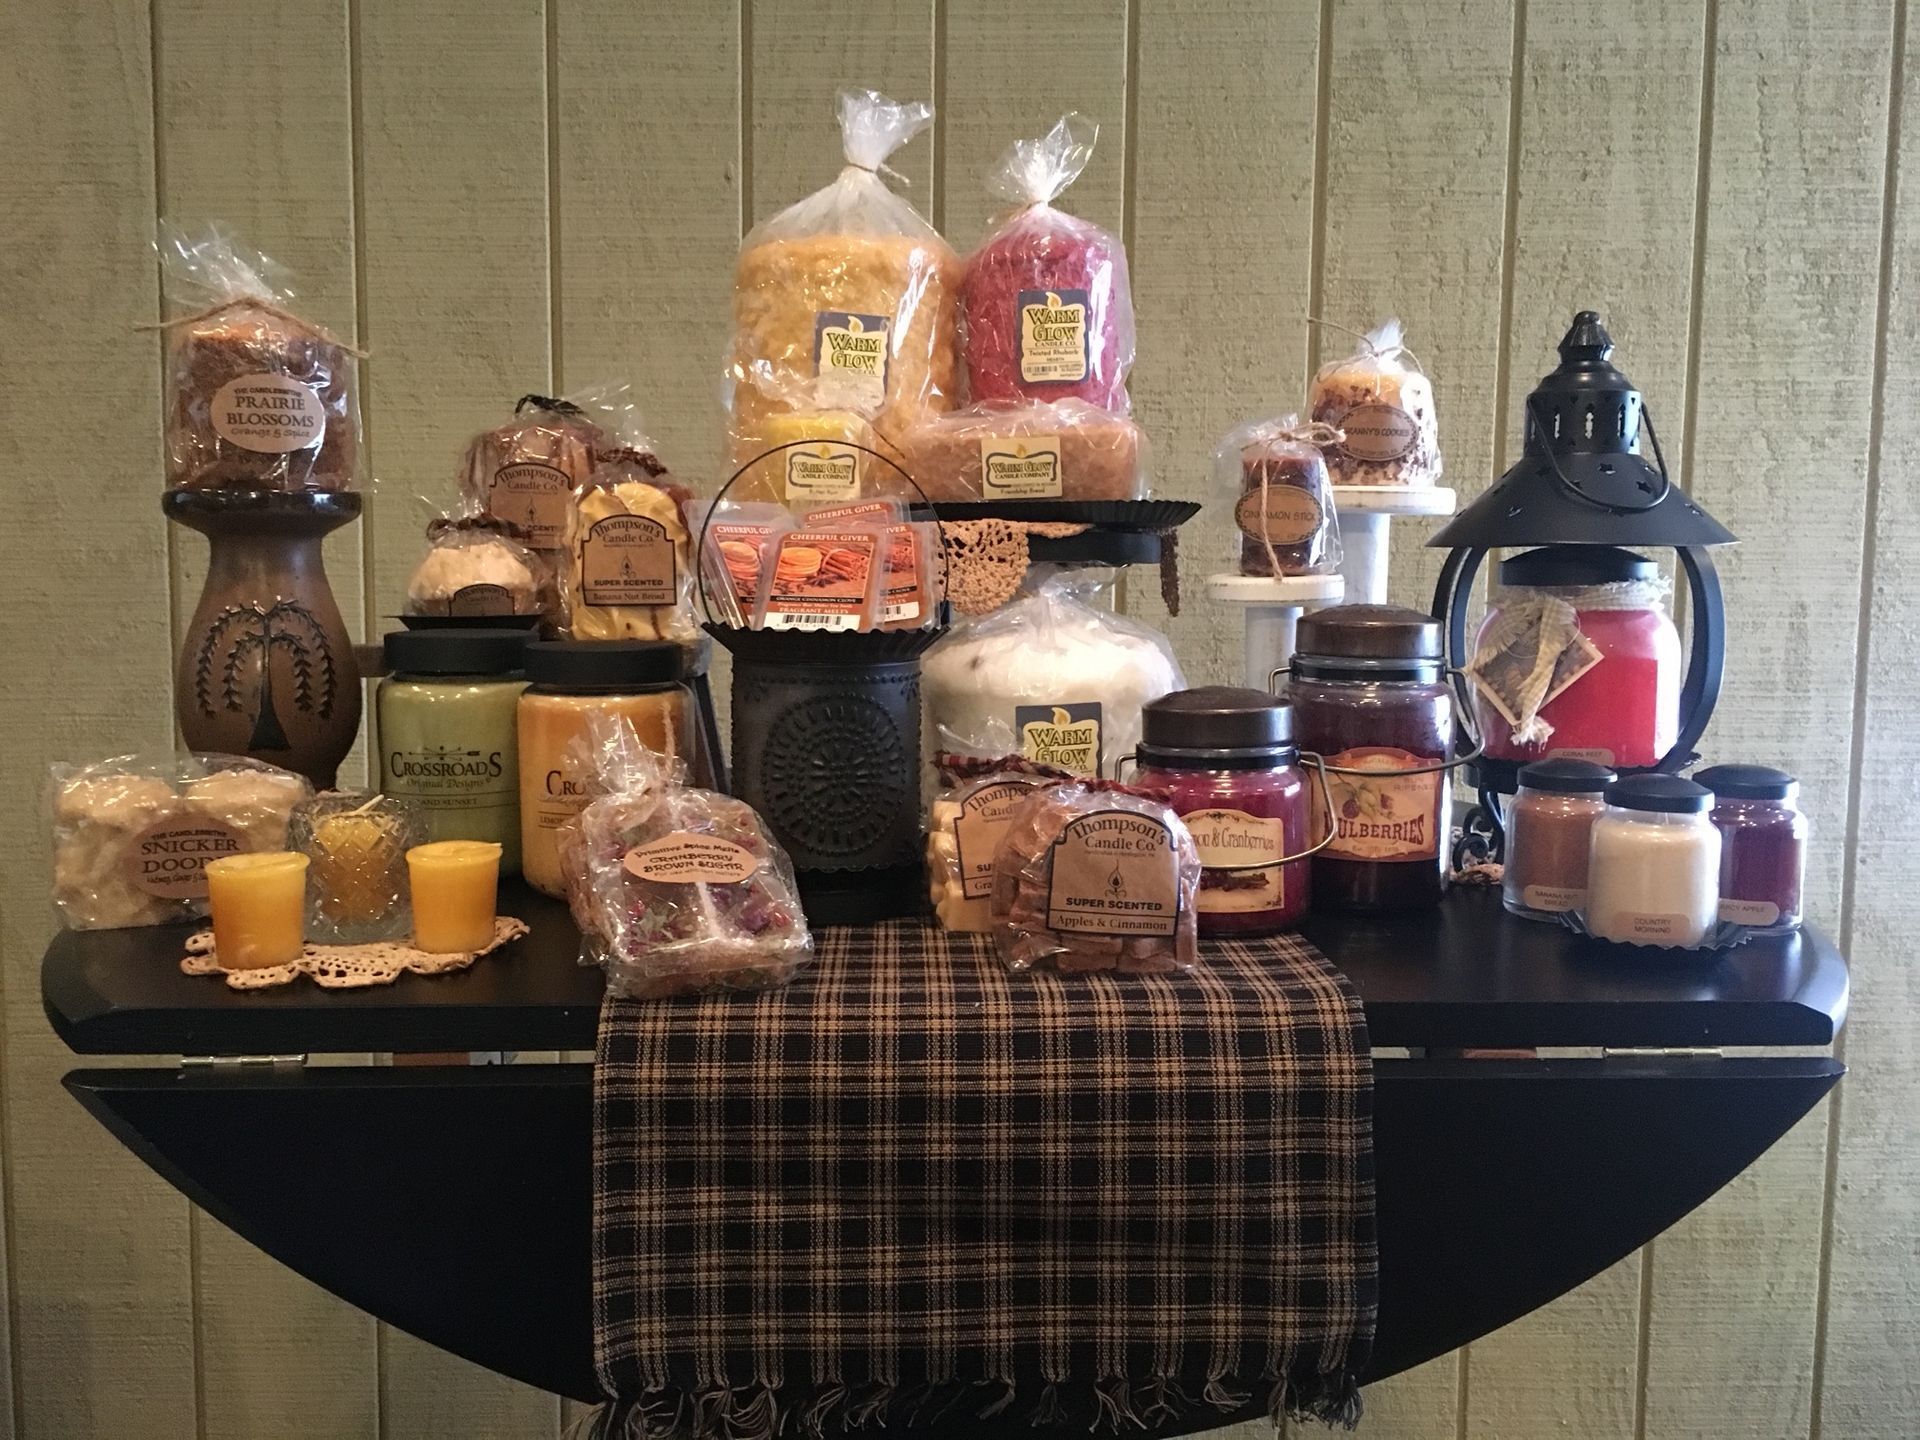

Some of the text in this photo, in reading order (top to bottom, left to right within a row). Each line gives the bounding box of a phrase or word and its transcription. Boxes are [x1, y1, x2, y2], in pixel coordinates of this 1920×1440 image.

[1026, 308, 1080, 325] WARM
[1033, 325, 1079, 342] GLOW
[826, 332, 882, 353] WARM
[831, 350, 878, 371] GLOW
[235, 396, 306, 411] PRAIRIE
[226, 412, 314, 428] BLOSSOMS
[990, 460, 1053, 474] WARM GLOW
[500, 468, 566, 487] Thompson's
[507, 481, 541, 490] Candle
[808, 503, 882, 522] CHEERFUL GIVER
[1243, 510, 1291, 520] CINAMON
[594, 520, 661, 538] Thompson's
[717, 526, 758, 535] CHEERFUL
[886, 525, 907, 534] IVER
[602, 533, 637, 543] Candle
[790, 533, 869, 542] CHEERFUL GIVER
[593, 593, 622, 601] Banana
[624, 593, 639, 601] Nut
[1028, 728, 1092, 747] WARM
[1035, 747, 1091, 765] GLOW
[390, 751, 502, 778] CROSSROADS
[1068, 818, 1167, 846] Thompson's
[1221, 826, 1274, 851] Cranberries
[141, 838, 240, 856] SNICKER
[1085, 836, 1133, 850] Candle
[142, 856, 215, 874] DOOD
[643, 860, 745, 873] BROWN SUGAR
[649, 853, 733, 864] CRANBERRY
[1066, 897, 1163, 911] SUPER SCENTED
[1057, 914, 1167, 930] Apples & Cinnamon
